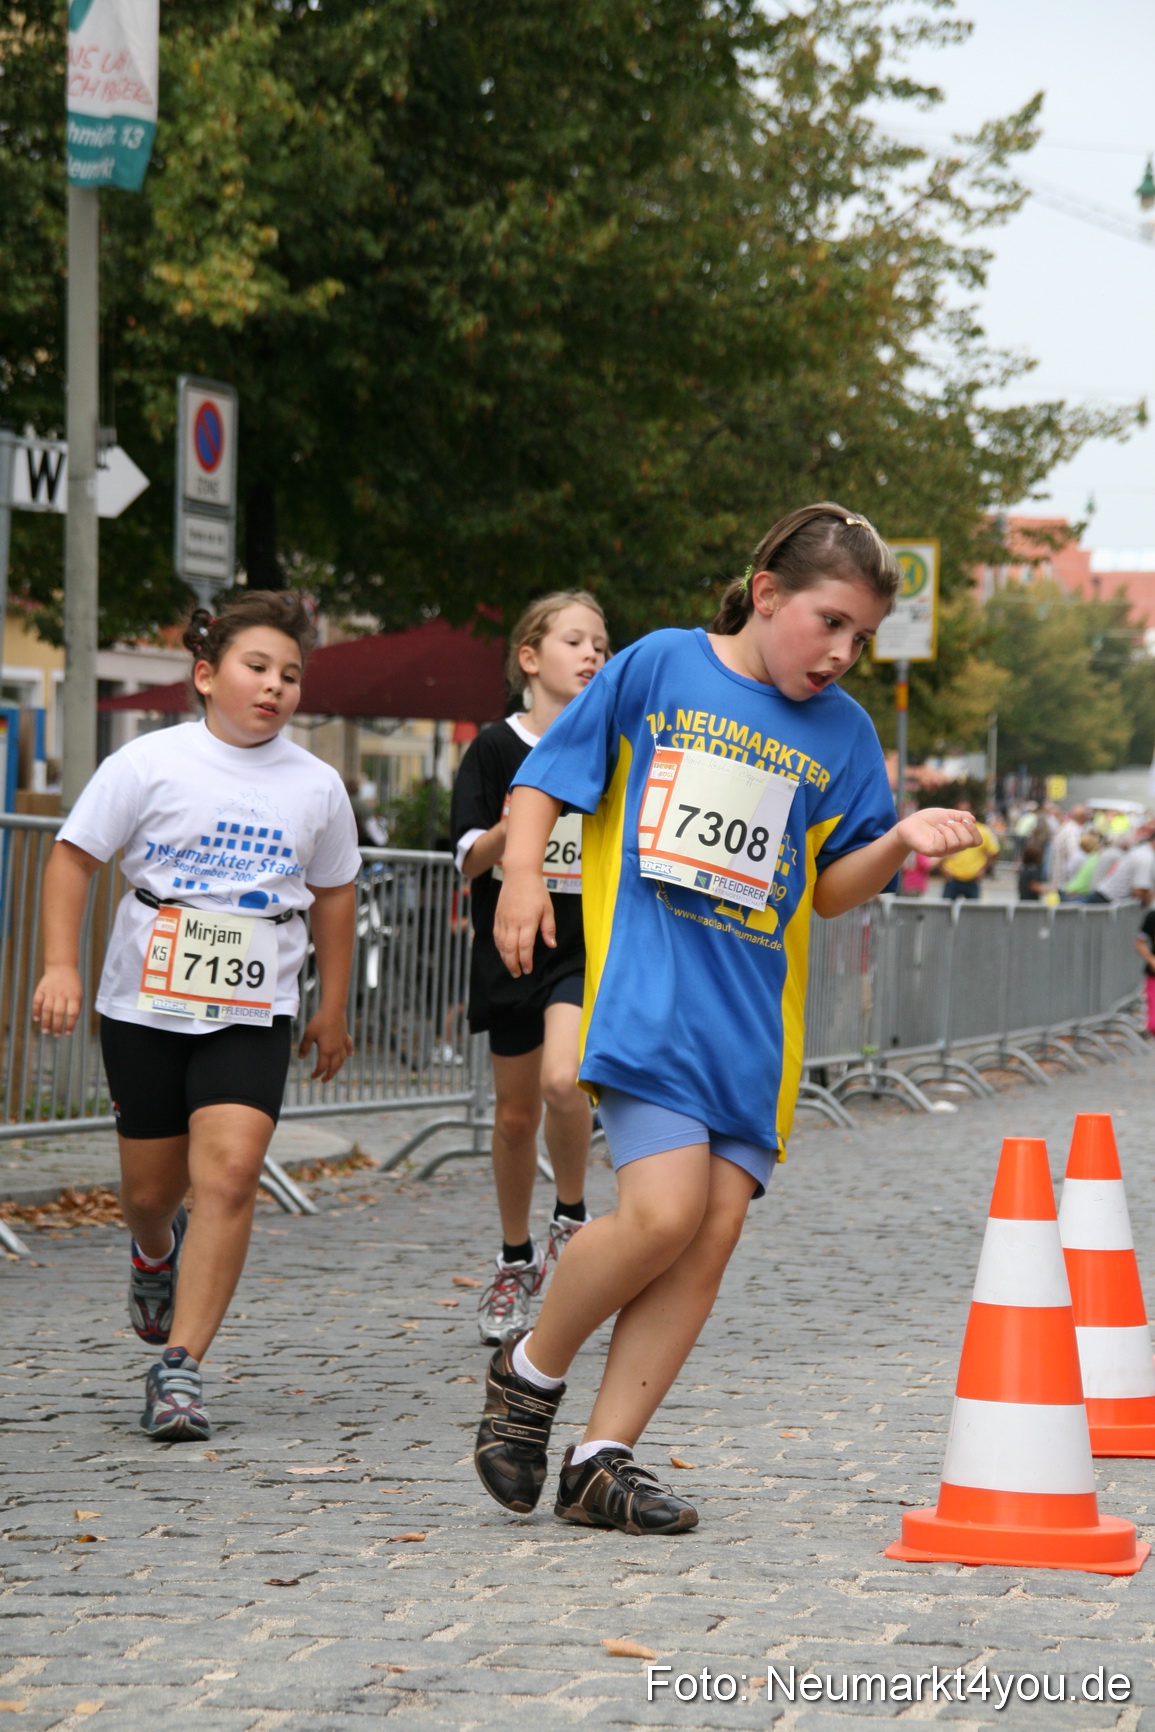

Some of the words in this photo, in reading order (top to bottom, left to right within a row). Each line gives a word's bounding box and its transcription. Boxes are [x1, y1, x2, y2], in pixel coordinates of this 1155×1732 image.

[121, 125, 145, 149] 13
[676, 709, 831, 792] NEUMARKTER
[675, 804, 769, 862] 7308
[158, 844, 255, 872] Neumarkter
[173, 858, 229, 880] September
[713, 875, 766, 902] PFLEIDERER
[184, 918, 242, 946] Mirjam
[183, 952, 266, 989] 7139
[221, 1005, 270, 1019] PFLEIDERER
